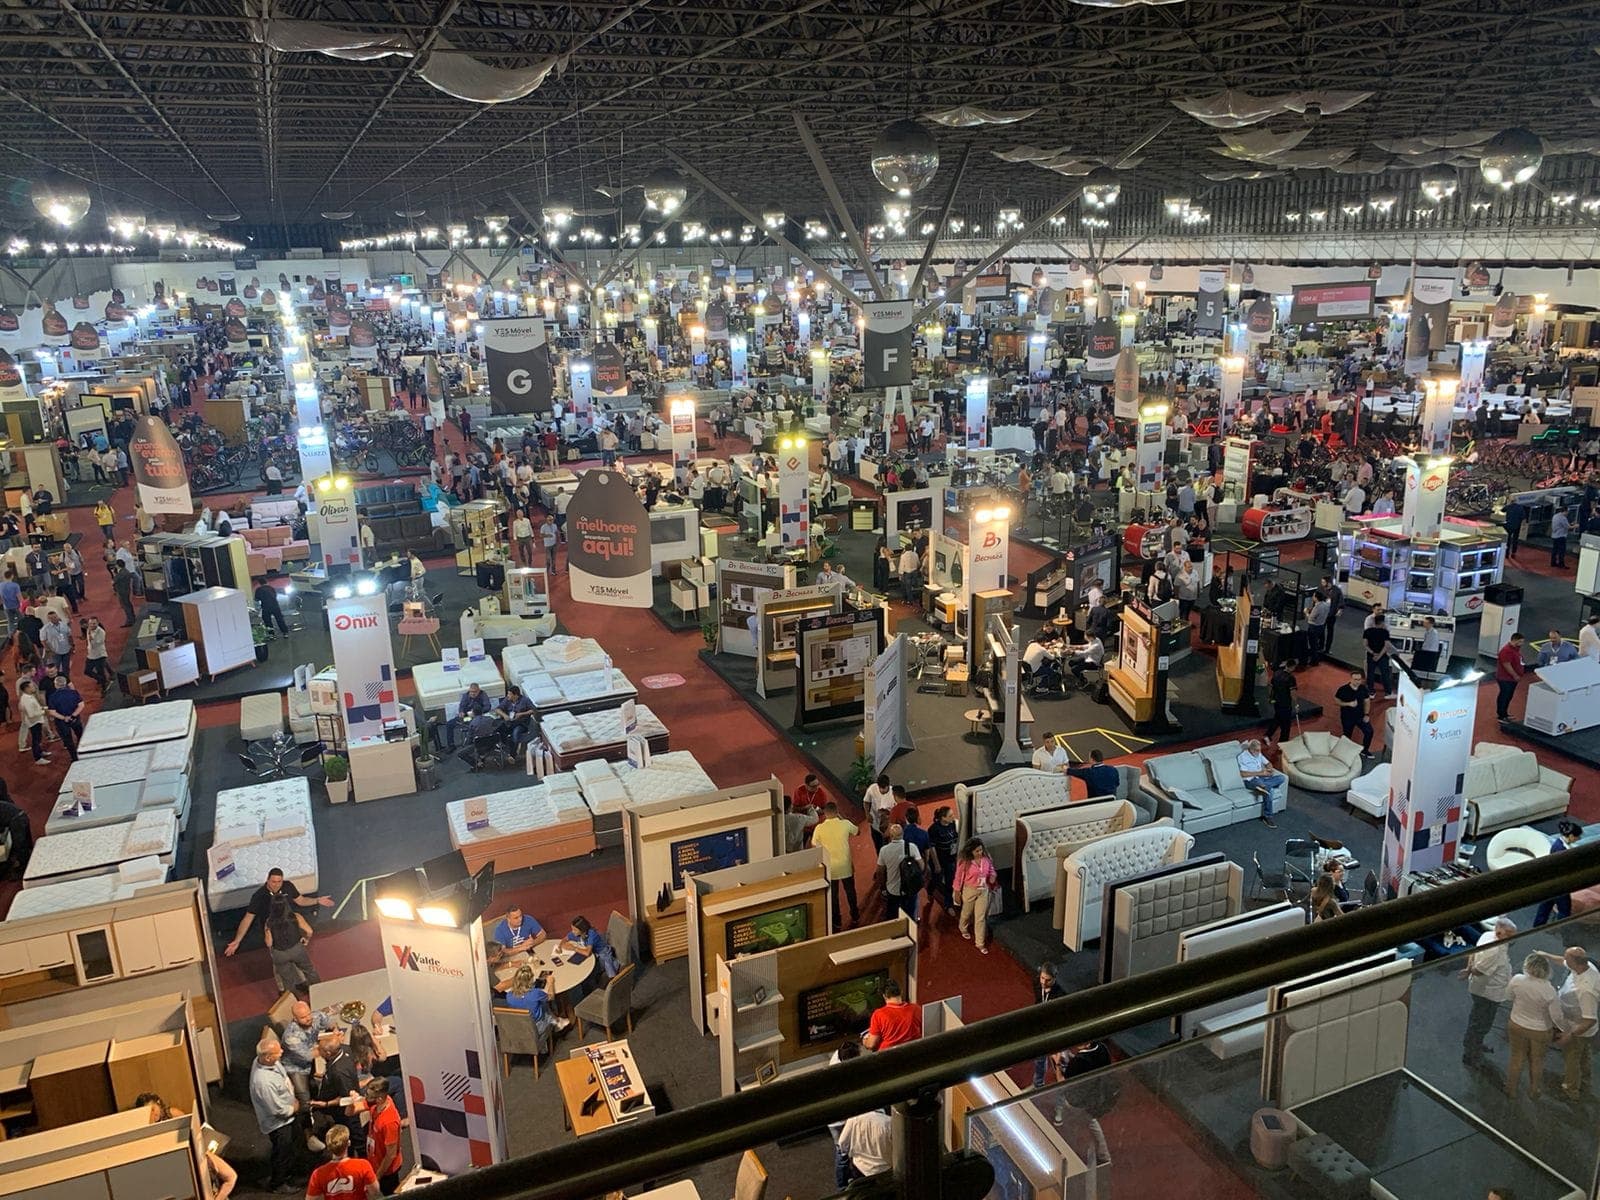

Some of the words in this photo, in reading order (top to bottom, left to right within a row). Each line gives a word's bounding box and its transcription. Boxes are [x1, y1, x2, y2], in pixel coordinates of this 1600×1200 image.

[1054, 299, 1060, 312] 6
[1206, 301, 1215, 317] 5
[883, 348, 898, 372] F
[507, 368, 533, 395] G
[576, 518, 638, 534] melhores
[582, 537, 635, 561] aqui!
[589, 585, 606, 593] YES
[606, 586, 629, 595] Móvel
[412, 951, 441, 966] Valde
